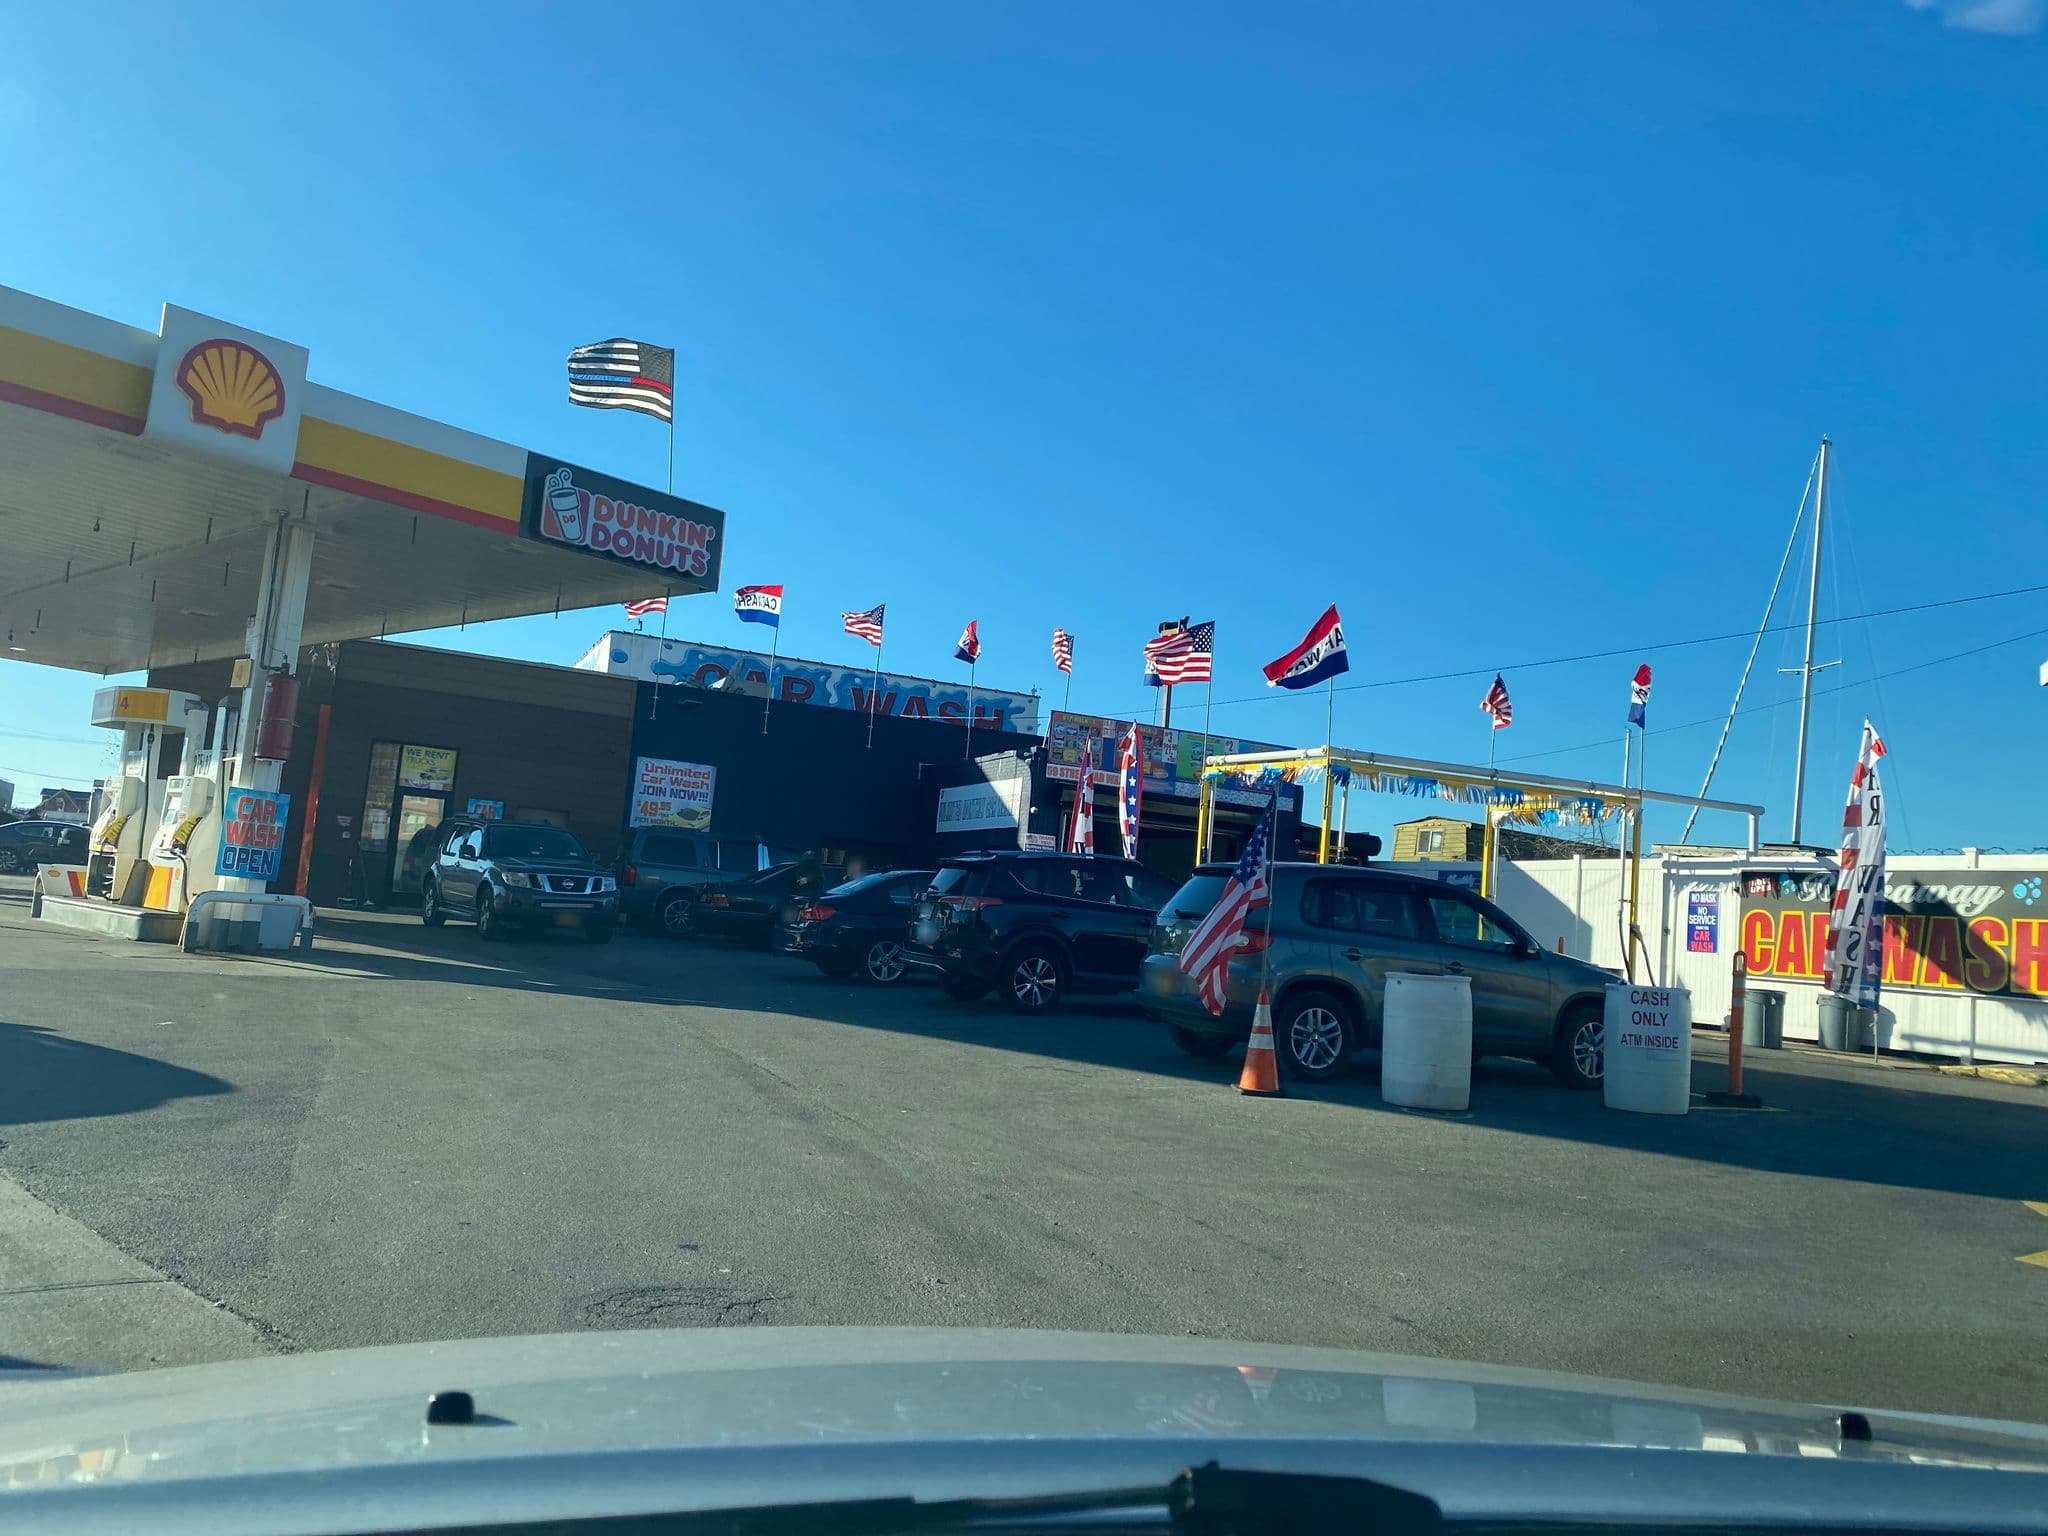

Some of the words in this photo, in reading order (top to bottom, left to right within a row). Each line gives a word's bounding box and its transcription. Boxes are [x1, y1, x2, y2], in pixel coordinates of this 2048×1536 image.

[593, 495, 715, 549] DUNKIN'
[590, 522, 707, 576] DONUTS
[119, 696, 129, 710] 4
[850, 686, 1004, 731] WASH
[406, 747, 422, 758] WE
[425, 750, 451, 761] RENT
[644, 762, 711, 780] Unlimited
[640, 773, 666, 785] Car
[670, 776, 710, 791] Wash
[639, 784, 667, 798] JOIN
[669, 788, 709, 803] NOW!!!
[237, 796, 277, 825] CAR
[225, 820, 283, 849] WASH
[221, 846, 275, 875] OPEN
[1691, 892, 1700, 903] NO
[1700, 893, 1717, 904] MASK
[1697, 906, 1708, 916] NO
[1688, 915, 1717, 926] SERVICE
[1694, 930, 1711, 941] CAR
[1691, 940, 1714, 953] WASH
[1630, 990, 1670, 1007] CASH
[1631, 1010, 1670, 1027] ONLY
[1620, 1033, 1642, 1046] ATM
[1644, 1034, 1679, 1049] INSIDE
